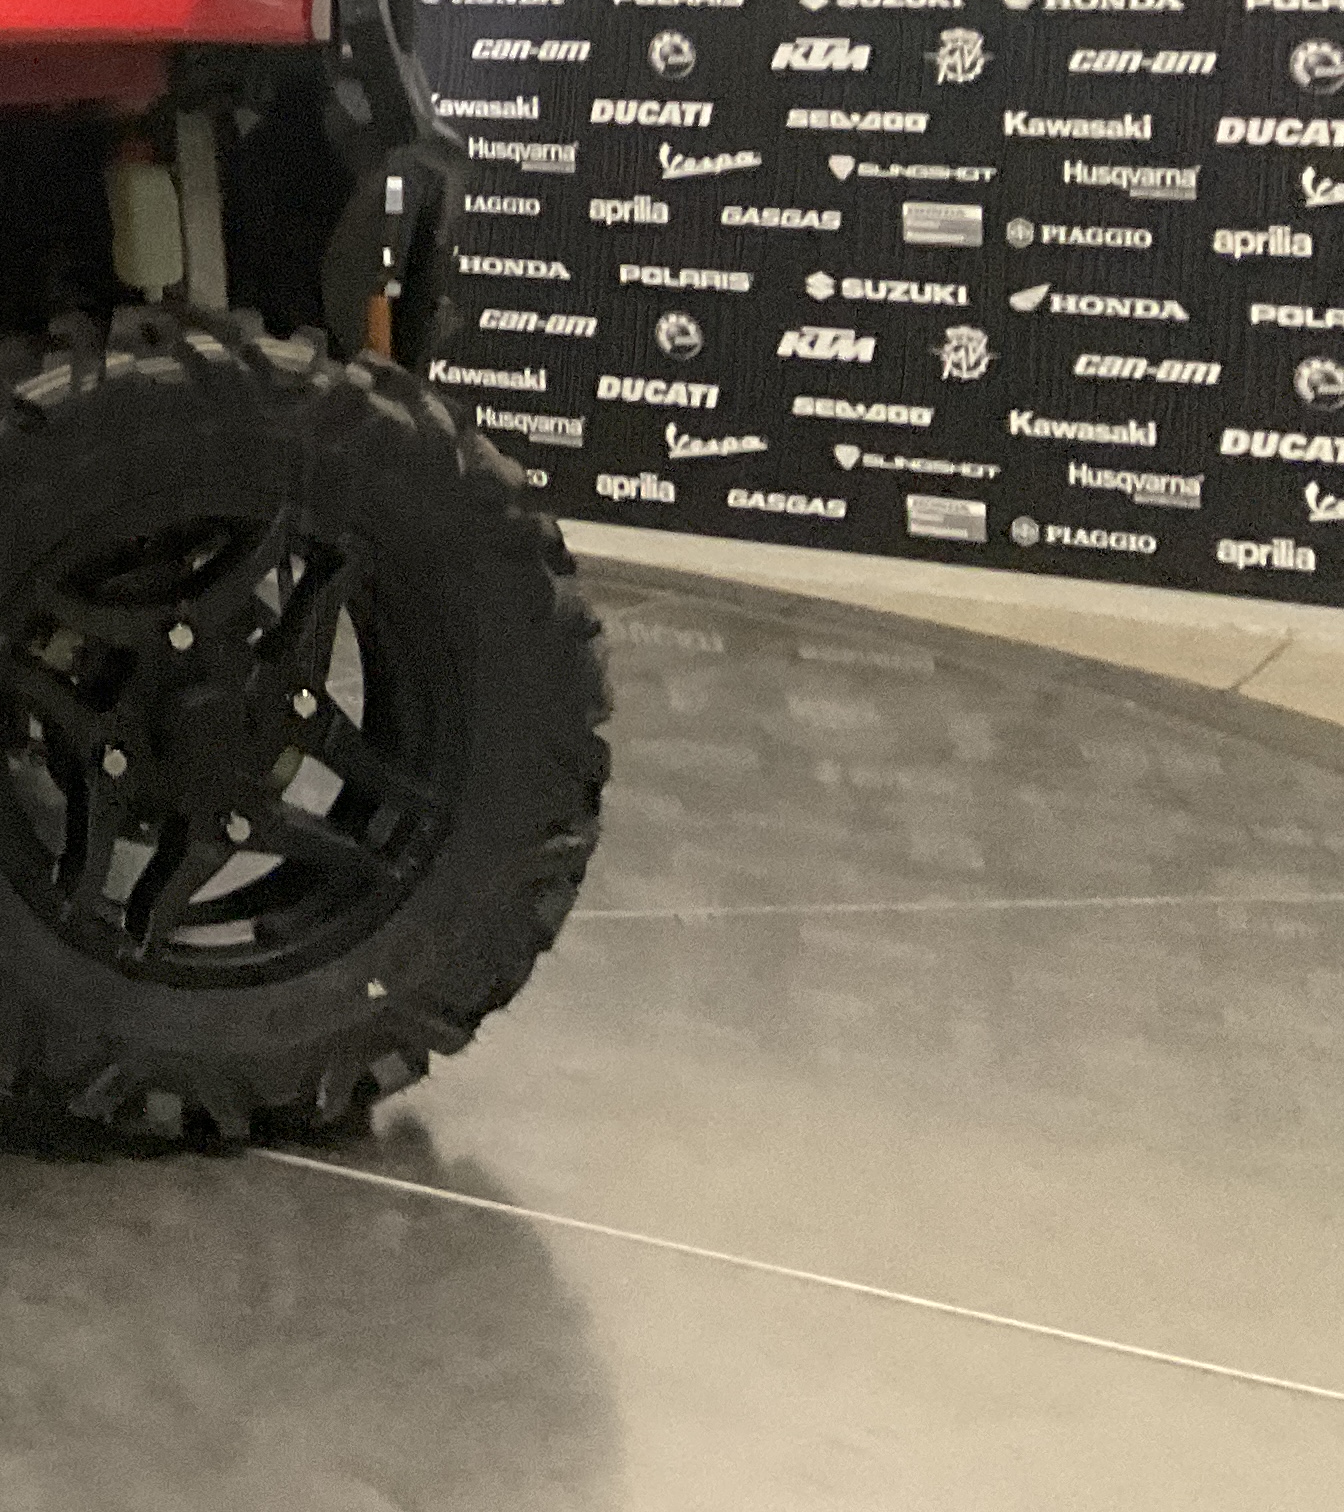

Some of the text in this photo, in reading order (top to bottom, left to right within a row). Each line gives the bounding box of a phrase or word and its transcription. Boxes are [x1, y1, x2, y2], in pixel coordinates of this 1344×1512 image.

[772, 38, 870, 70] KTM
[591, 99, 713, 126] DUCATI
[1005, 111, 1151, 139] Kawasaki
[1216, 118, 1344, 146] DUCAT
[659, 143, 761, 178] Vespa
[465, 195, 540, 215] IAGGIO
[721, 206, 841, 230] GASGAS
[1042, 225, 1152, 248] PIAGGIO
[460, 256, 570, 279] HONDA
[620, 265, 750, 291] POLARIS
[842, 278, 967, 305] SUZUKI
[1051, 294, 1188, 320] HONDA
[1251, 304, 1344, 328] POLA
[777, 327, 875, 362] KTM
[429, 360, 546, 391] Kawasaki
[598, 376, 719, 408] DUCATI
[666, 423, 767, 458] Vespa
[1010, 410, 1156, 446] Kawasaki
[728, 489, 846, 517] GASGAS
[1046, 525, 1156, 553] PIAGGIO
